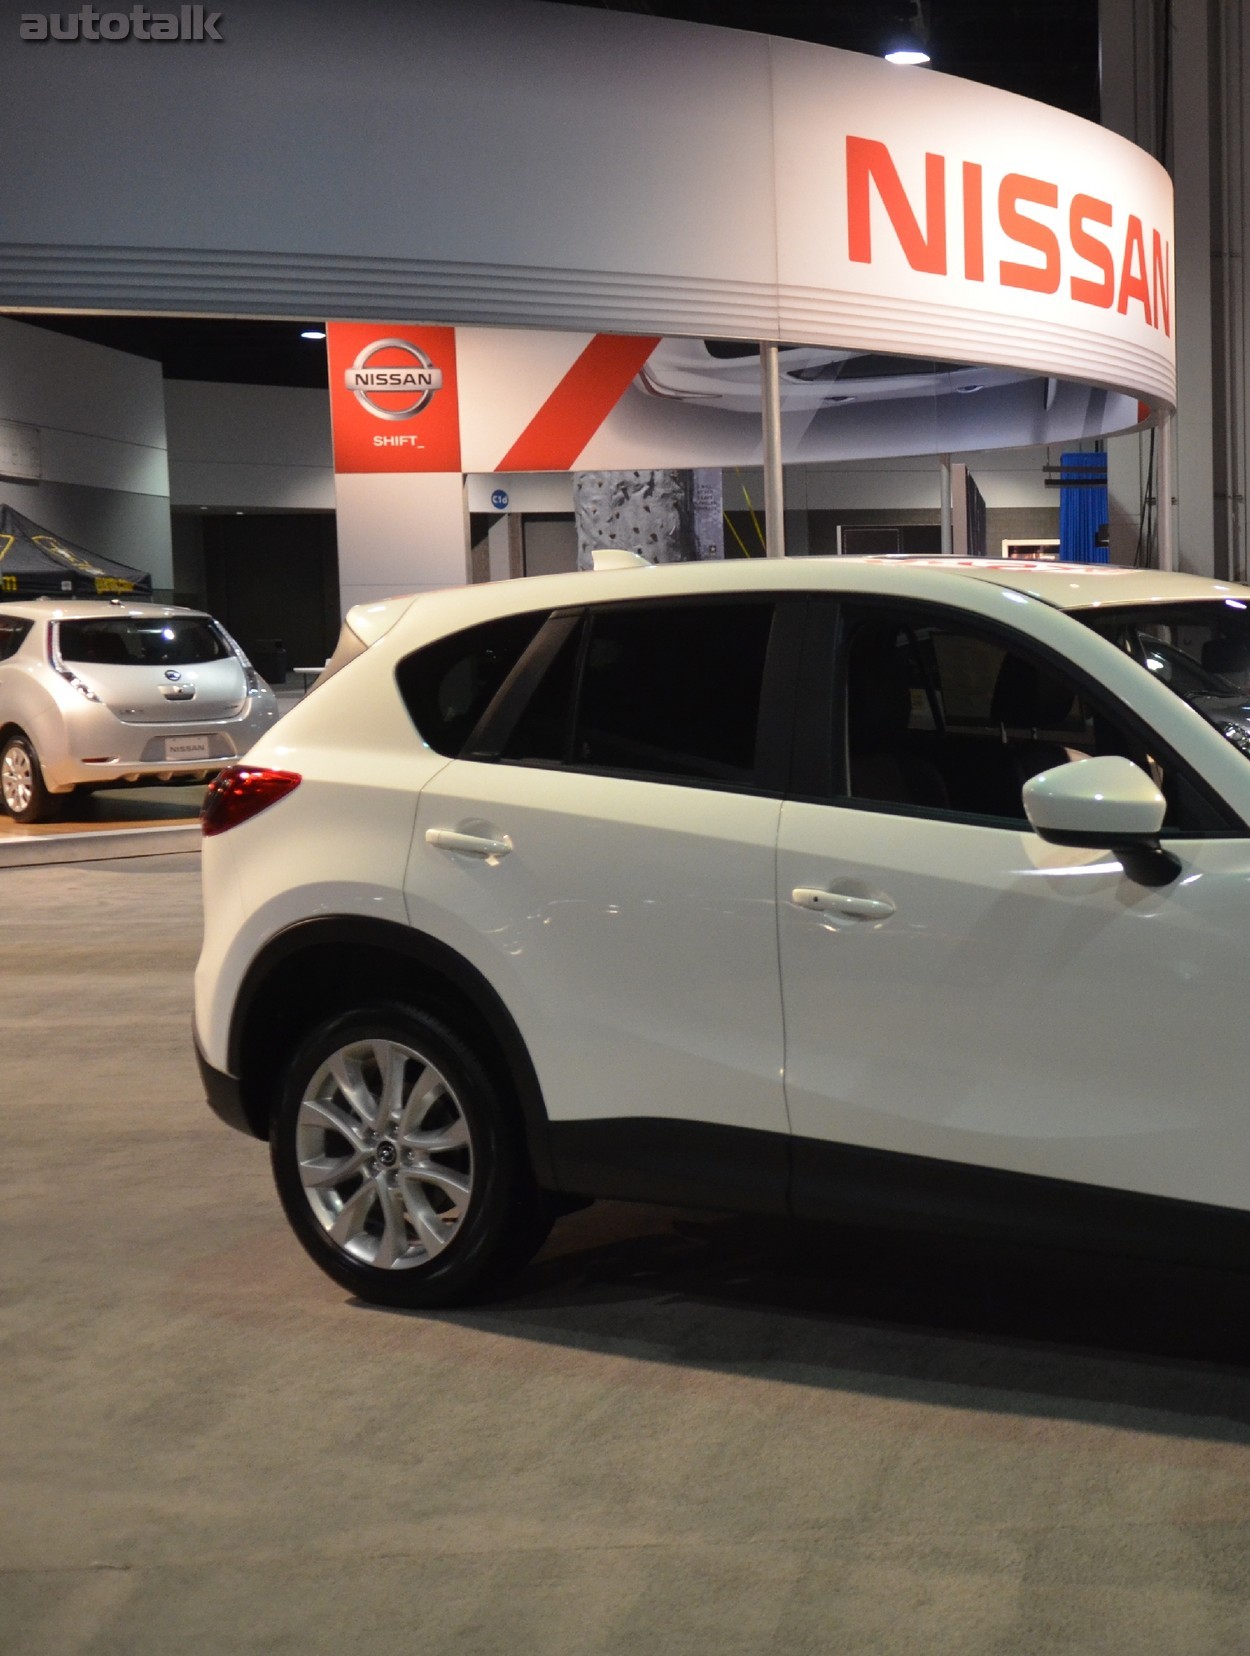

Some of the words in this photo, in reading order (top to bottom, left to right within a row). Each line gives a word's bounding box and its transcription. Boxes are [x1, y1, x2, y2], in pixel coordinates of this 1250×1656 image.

[845, 134, 1171, 339] NISSAN
[355, 373, 432, 386] NISSAN
[169, 744, 205, 753] NISSAN
